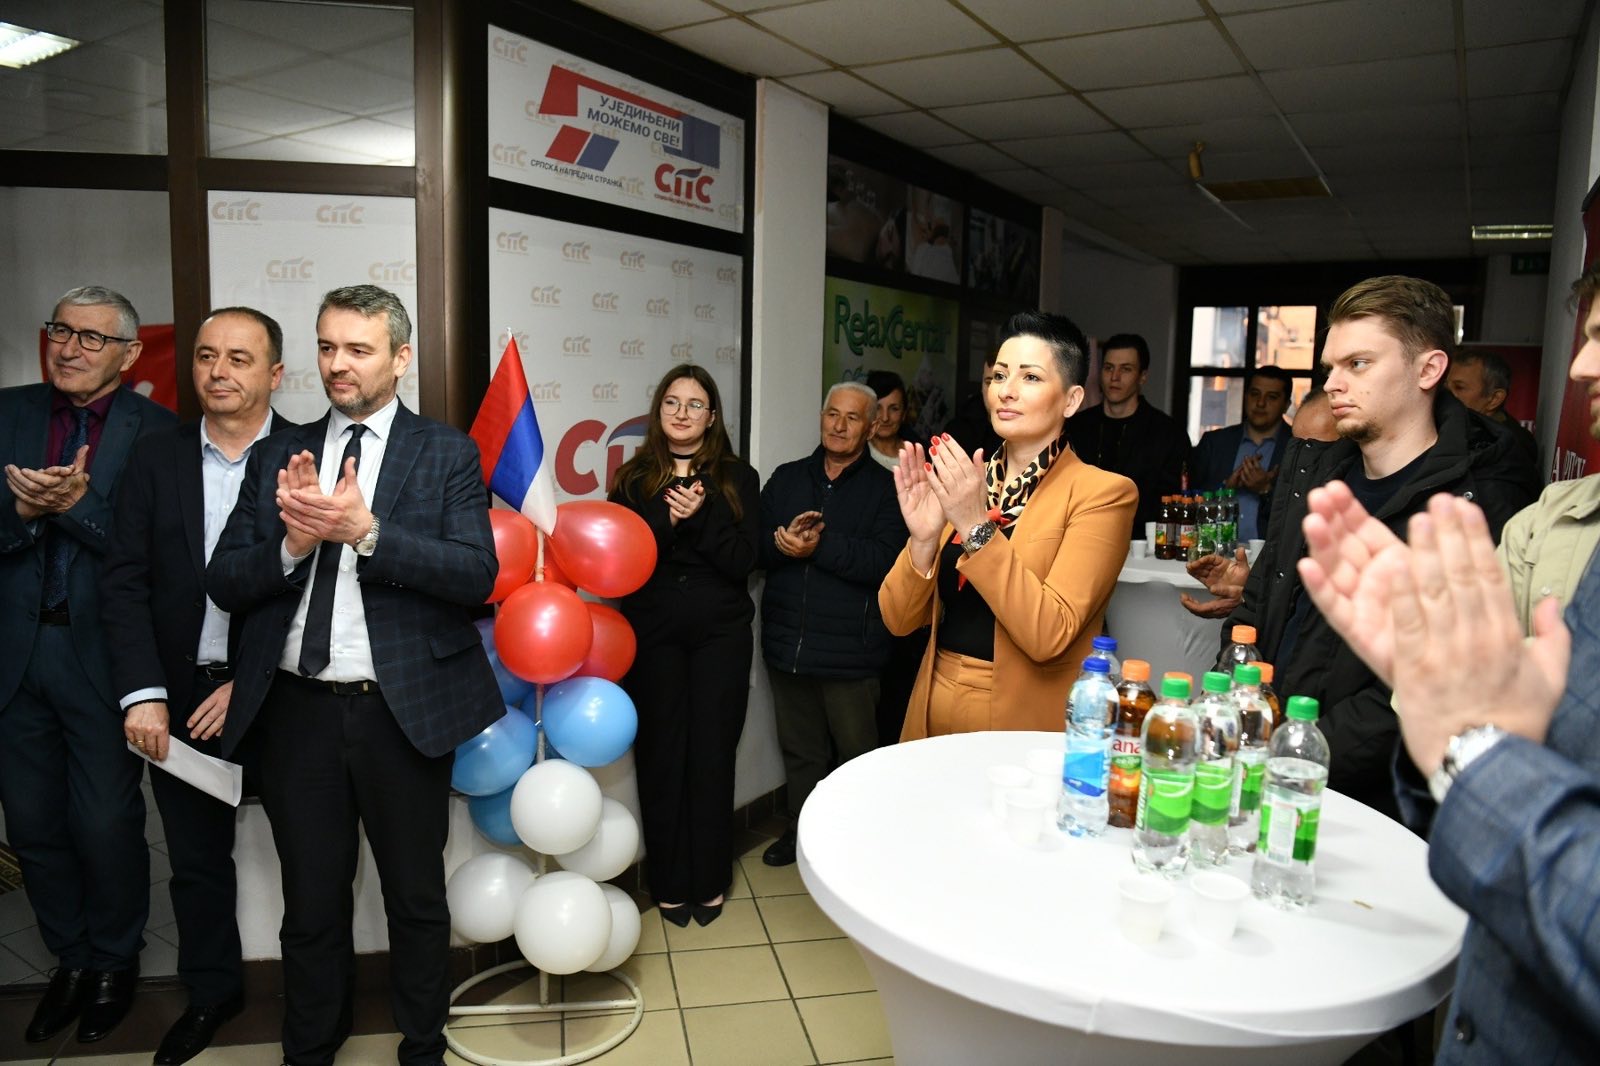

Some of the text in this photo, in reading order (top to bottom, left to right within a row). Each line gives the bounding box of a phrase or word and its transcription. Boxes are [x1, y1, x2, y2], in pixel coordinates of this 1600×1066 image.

[587, 108, 650, 137] МОЖЕМО
[654, 130, 680, 147] СВЕ!
[600, 95, 681, 132] УЈЕДИЊЕНИ
[530, 159, 623, 188] СРПСКА НАПРЕДНА СТРАНКА
[655, 163, 714, 204] СПС
